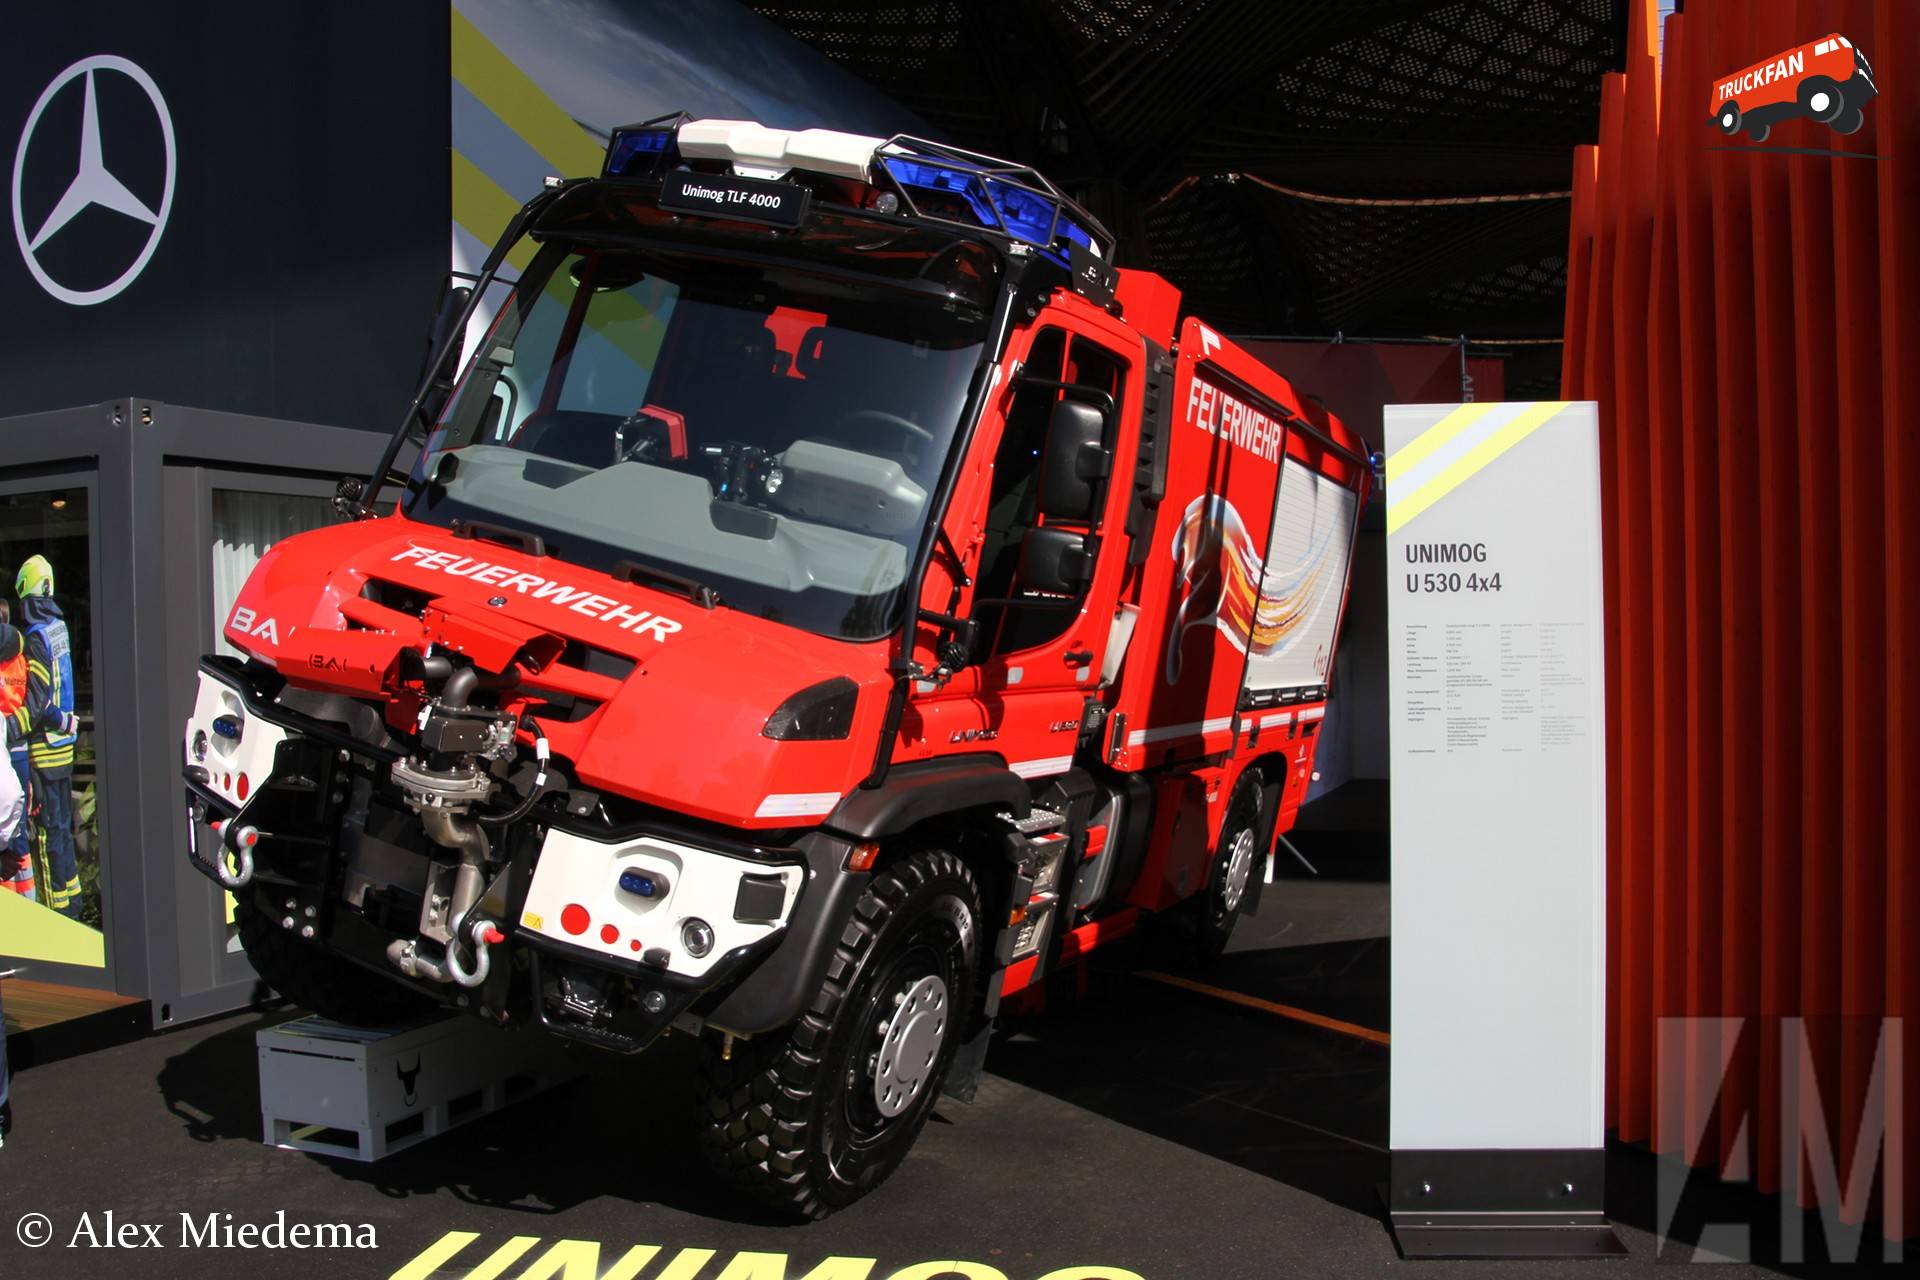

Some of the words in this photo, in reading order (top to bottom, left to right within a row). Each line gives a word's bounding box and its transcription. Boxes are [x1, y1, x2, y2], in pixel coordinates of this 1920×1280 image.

[682, 184, 725, 203] Unimog
[727, 190, 748, 203] TLF
[749, 194, 781, 208] 4000
[1186, 376, 1281, 464] FEUERWEHR
[1406, 543, 1487, 563] UNIMOG
[390, 544, 683, 643] FEUERWEHR
[1406, 573, 1419, 592] U
[1424, 573, 1461, 592] 530
[1466, 572, 1502, 592] 4x4
